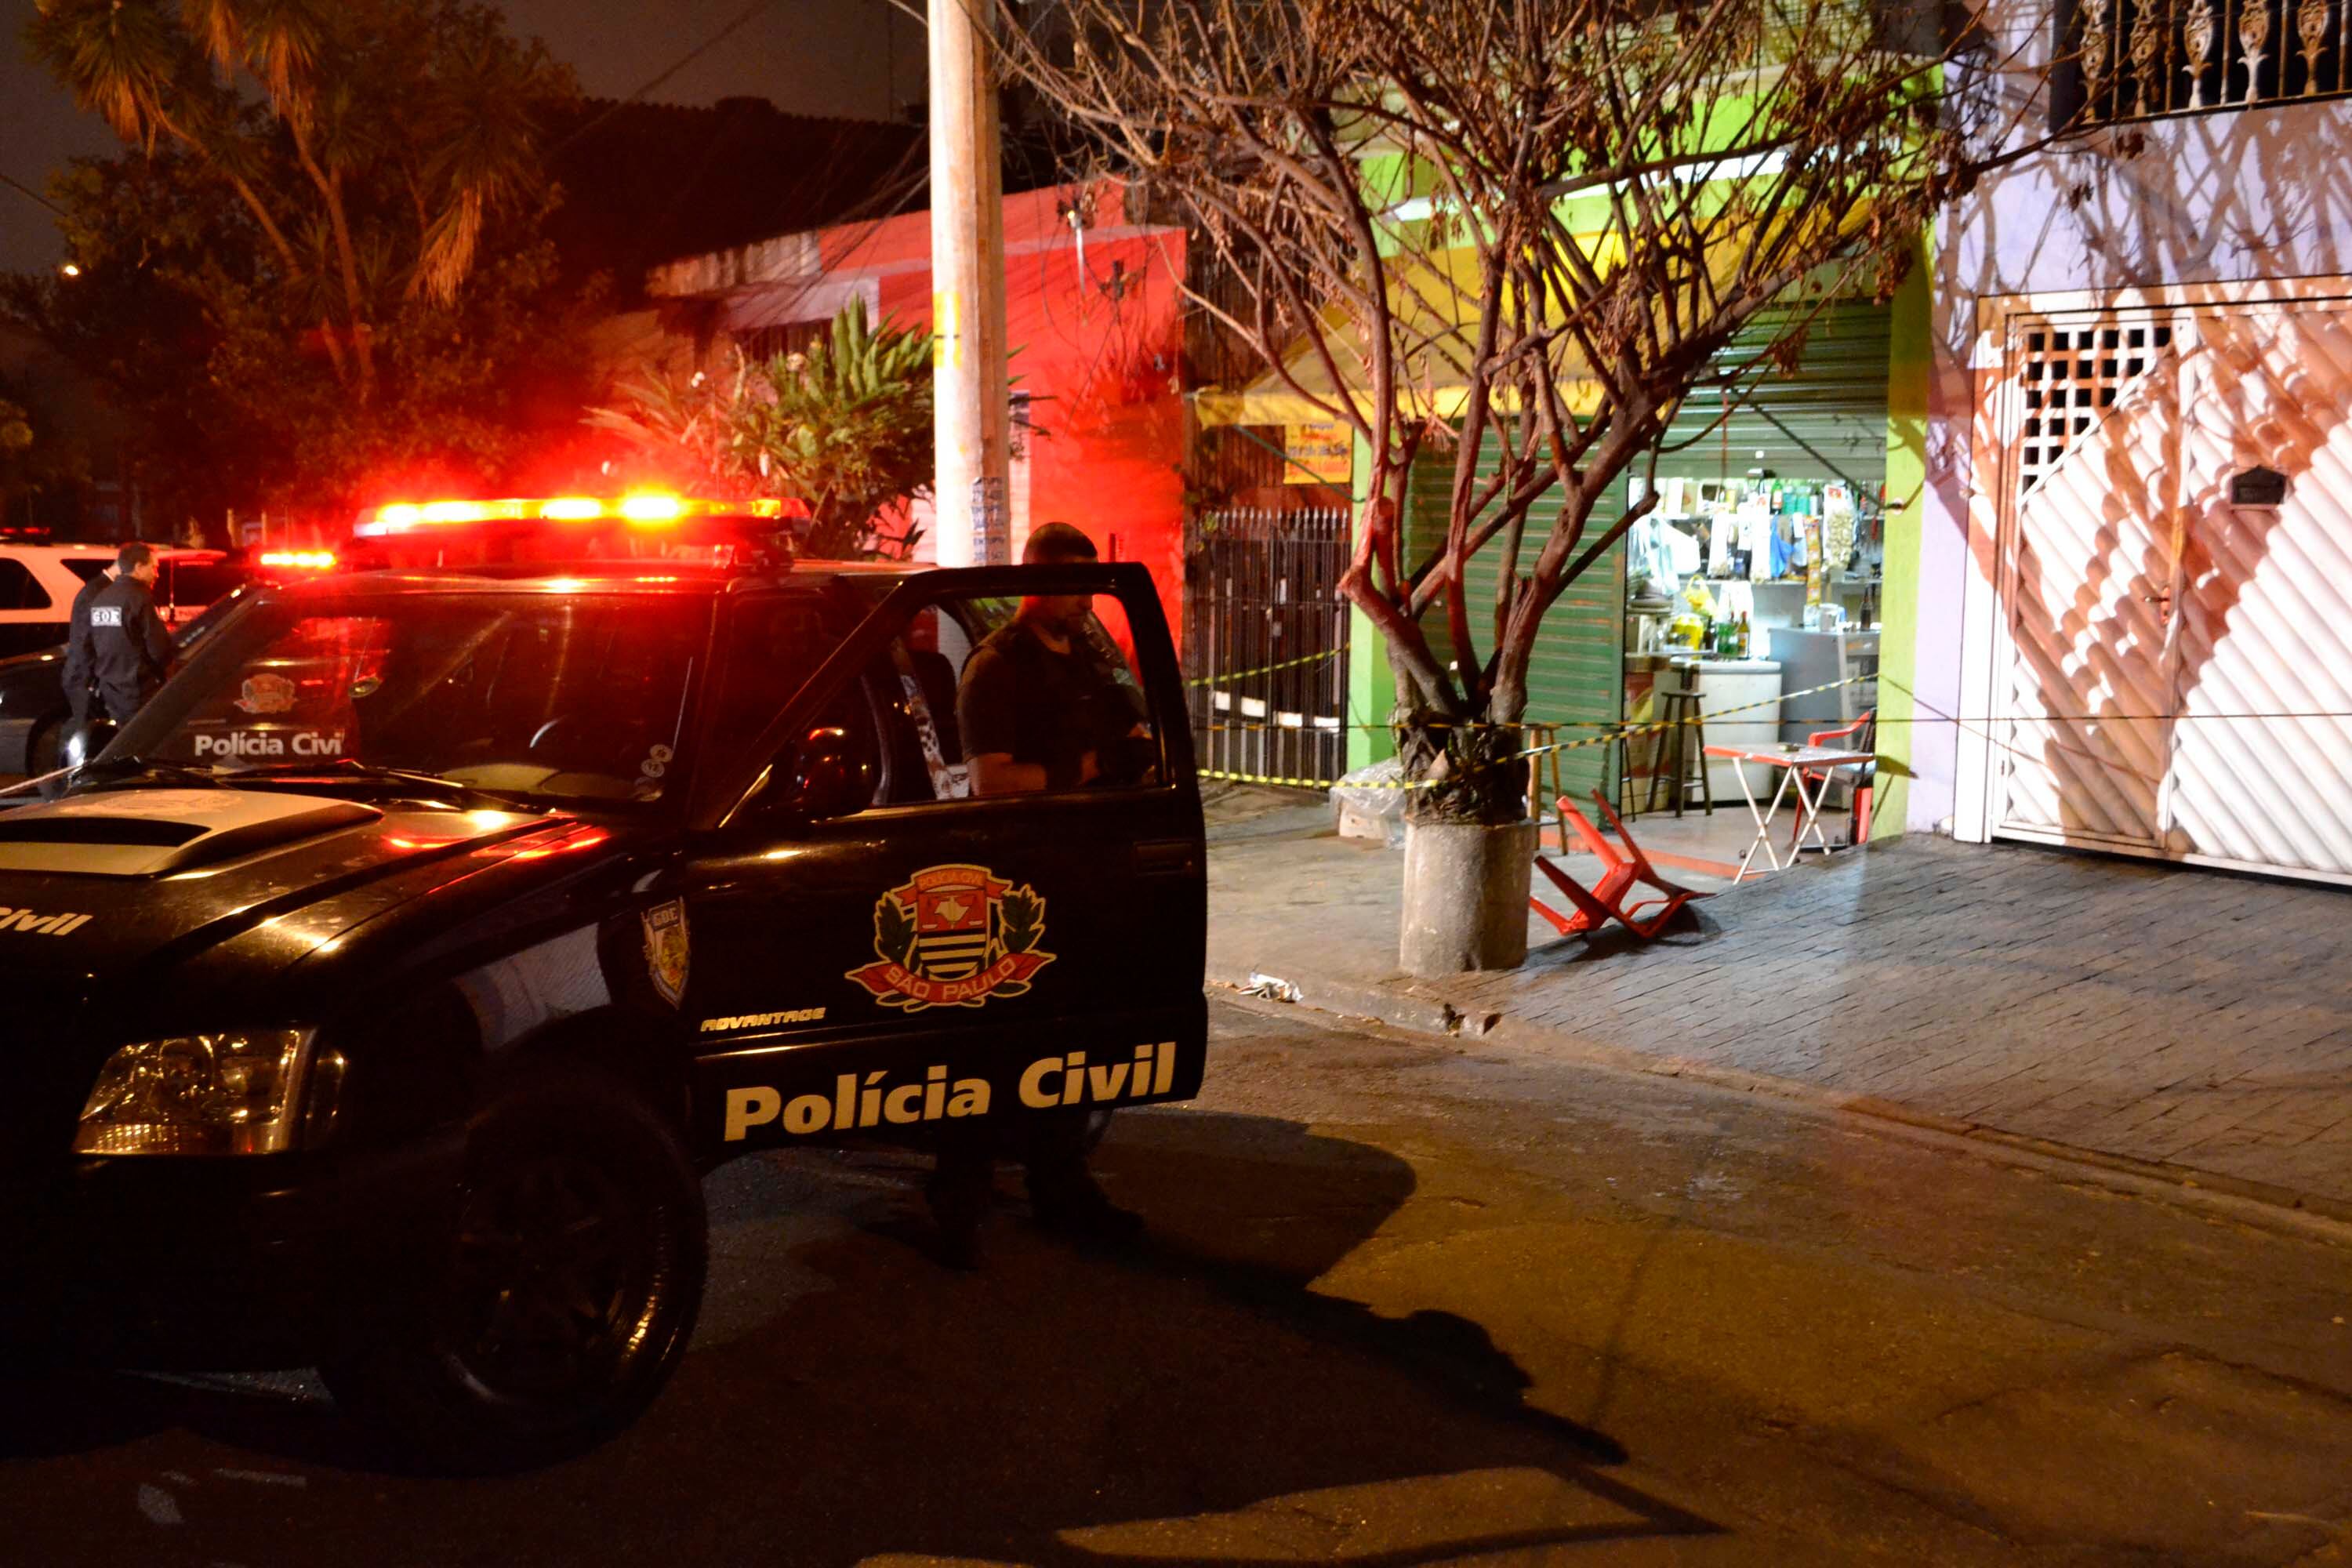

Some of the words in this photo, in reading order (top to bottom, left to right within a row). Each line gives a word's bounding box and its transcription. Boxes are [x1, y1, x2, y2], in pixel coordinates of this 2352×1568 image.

[195, 732, 284, 757] Polícia
[942, 958, 1017, 1000] PAULO
[700, 1007, 826, 1032] ADVANTAGE
[724, 1065, 991, 1142] Polícia
[1018, 1041, 1176, 1110] Civil
